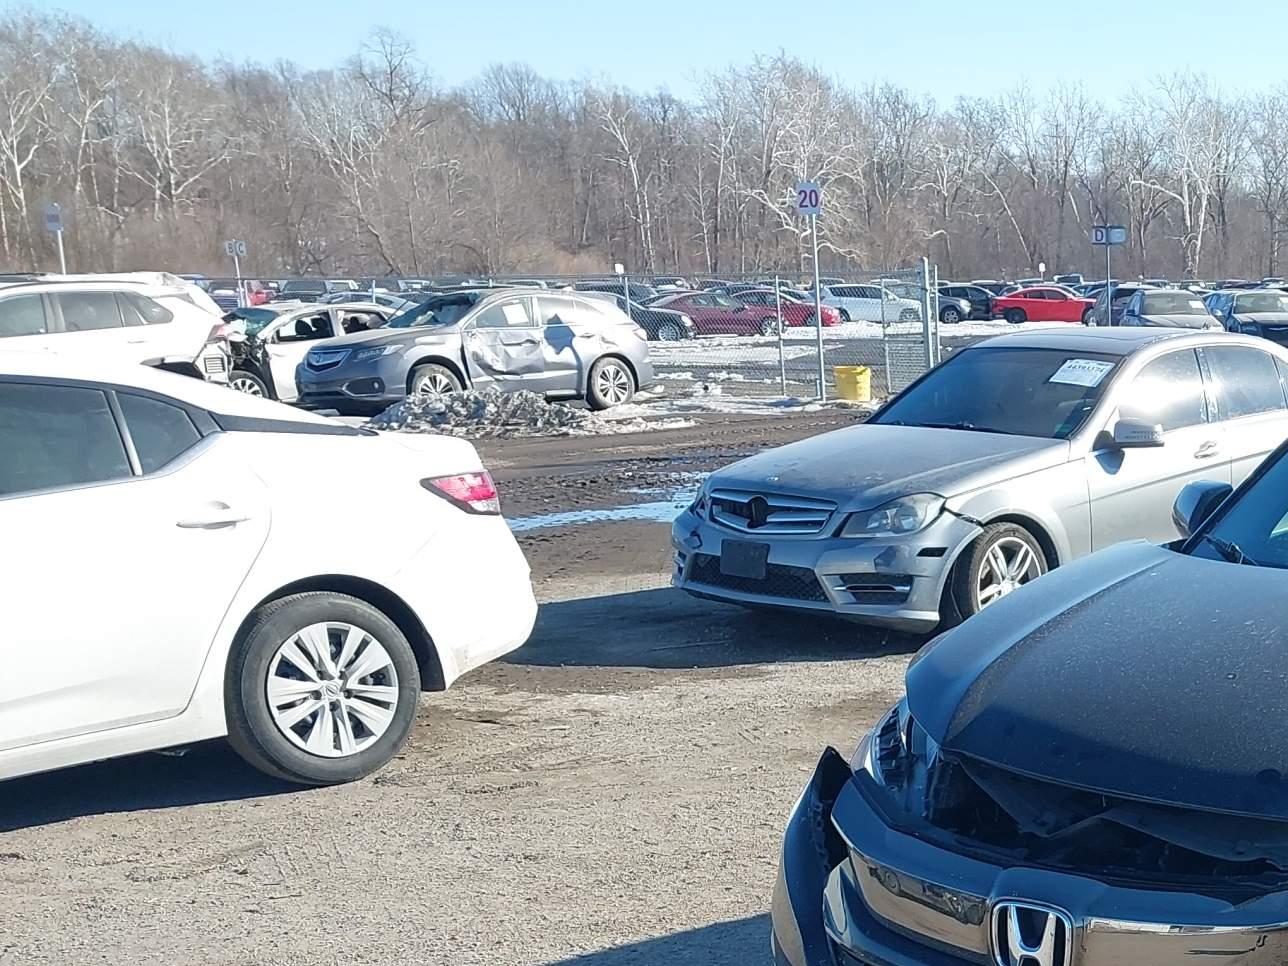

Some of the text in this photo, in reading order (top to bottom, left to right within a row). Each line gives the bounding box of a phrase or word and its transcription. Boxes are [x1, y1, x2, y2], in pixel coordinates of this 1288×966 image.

[798, 189, 818, 208] 20
[1094, 229, 1104, 241] D
[228, 242, 244, 253] B C
